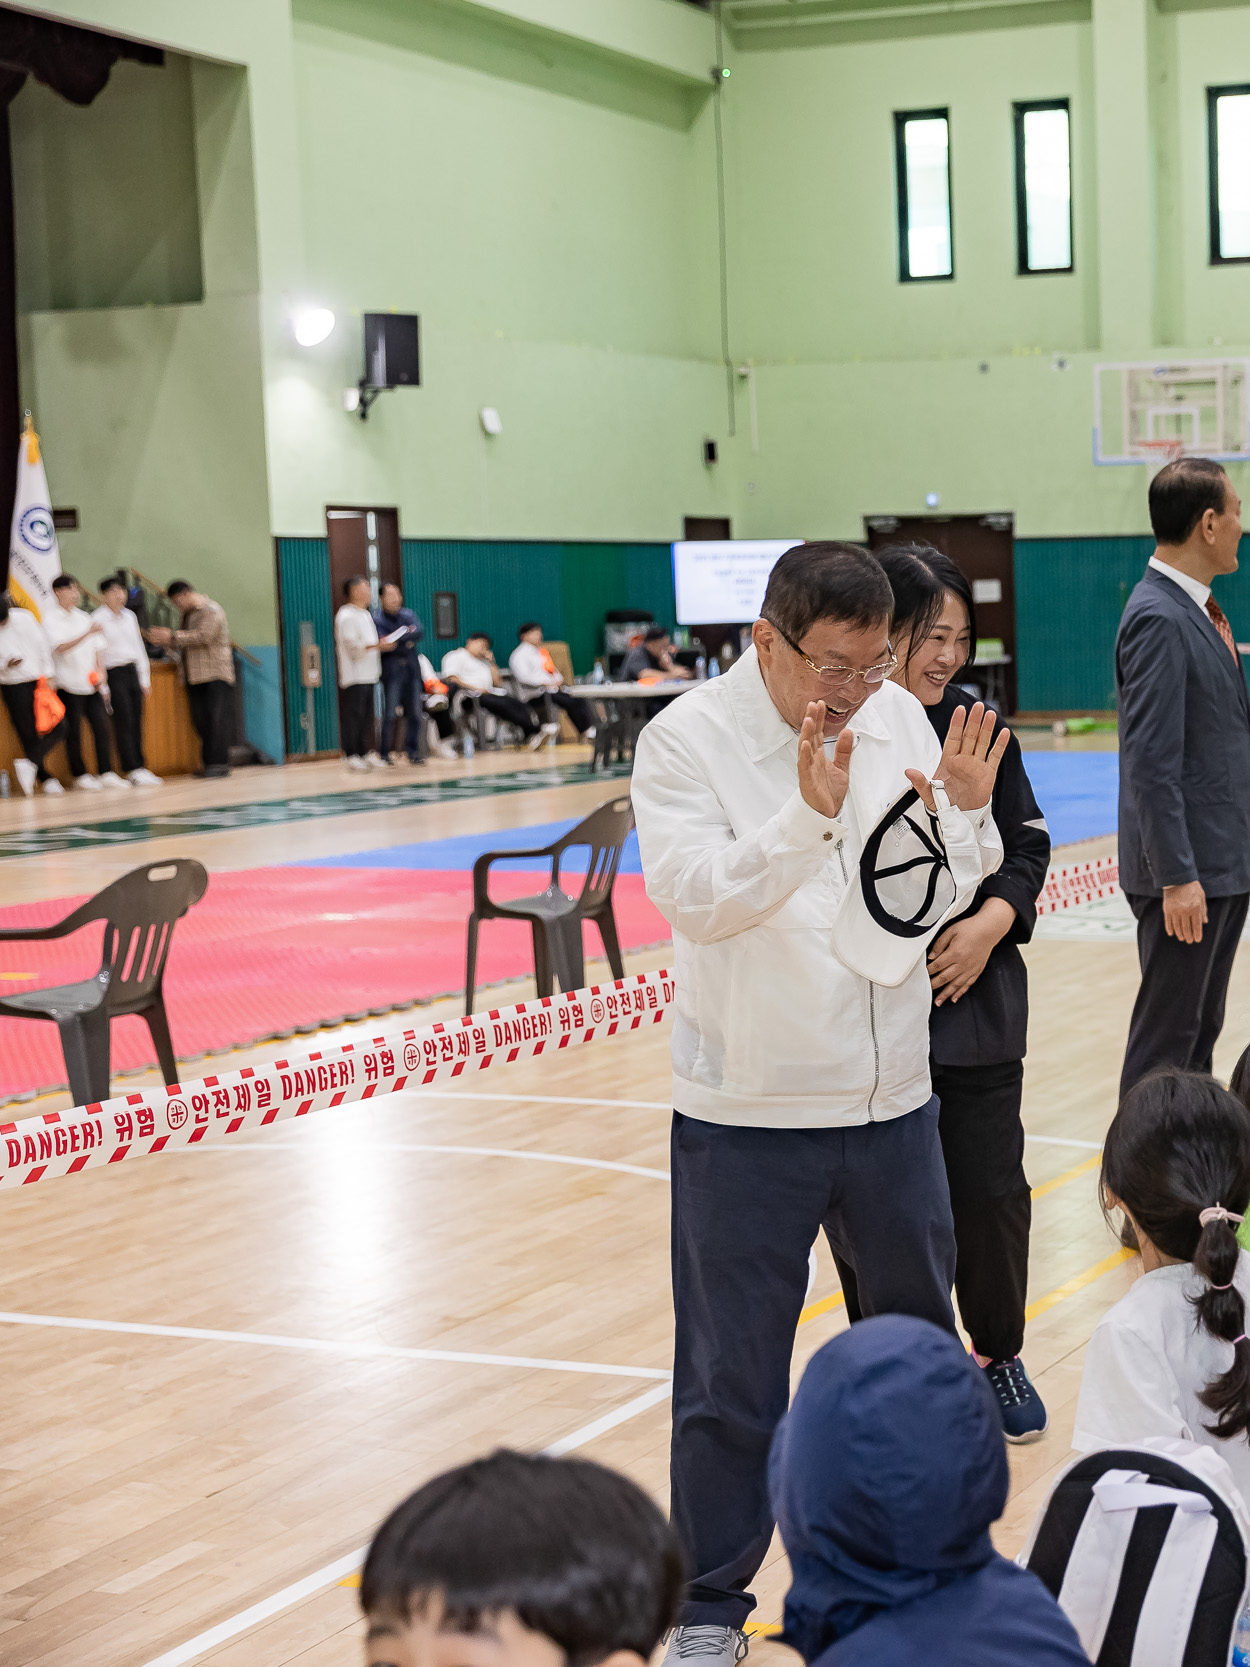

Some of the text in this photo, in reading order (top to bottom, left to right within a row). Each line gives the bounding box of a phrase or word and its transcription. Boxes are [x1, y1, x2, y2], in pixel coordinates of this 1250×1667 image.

[5, 1120, 103, 1168] DANGER!
[114, 1106, 155, 1142] 위험
[191, 1078, 271, 1124] 안전제일
[280, 1059, 355, 1100] DANGER!
[363, 1049, 395, 1081] 위험
[423, 1027, 486, 1066] 안전제일
[493, 1012, 552, 1048] DANGER!
[558, 1003, 584, 1032] 위험
[606, 985, 658, 1019] 안전제일
